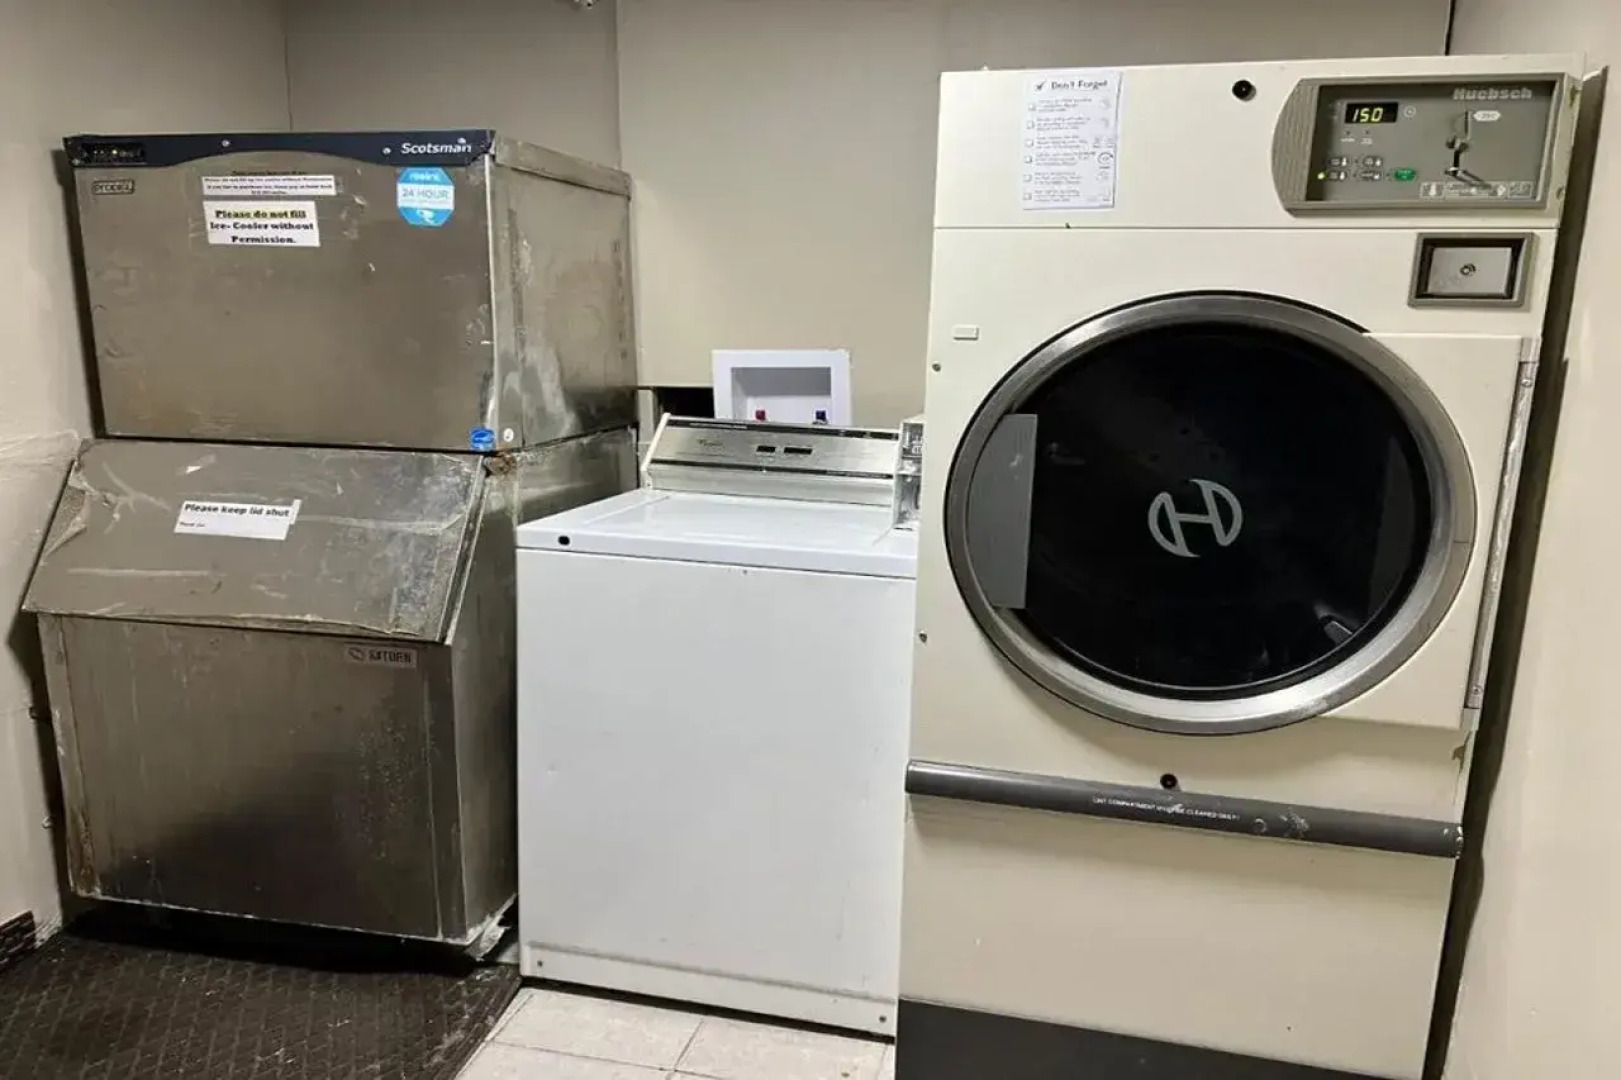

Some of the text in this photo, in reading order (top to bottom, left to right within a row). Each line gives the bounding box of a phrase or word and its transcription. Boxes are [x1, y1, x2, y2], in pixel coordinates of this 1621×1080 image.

[1452, 87, 1533, 101] Huebsch
[1352, 107, 1384, 122] 150
[401, 143, 472, 154] Scotsman
[402, 188, 448, 199] 24 HOUR
[215, 210, 306, 219] Please do not fill
[233, 222, 268, 230] Cooler
[270, 222, 314, 230] without
[231, 236, 296, 244] Permission.
[185, 503, 290, 517] Please keep lid shut
